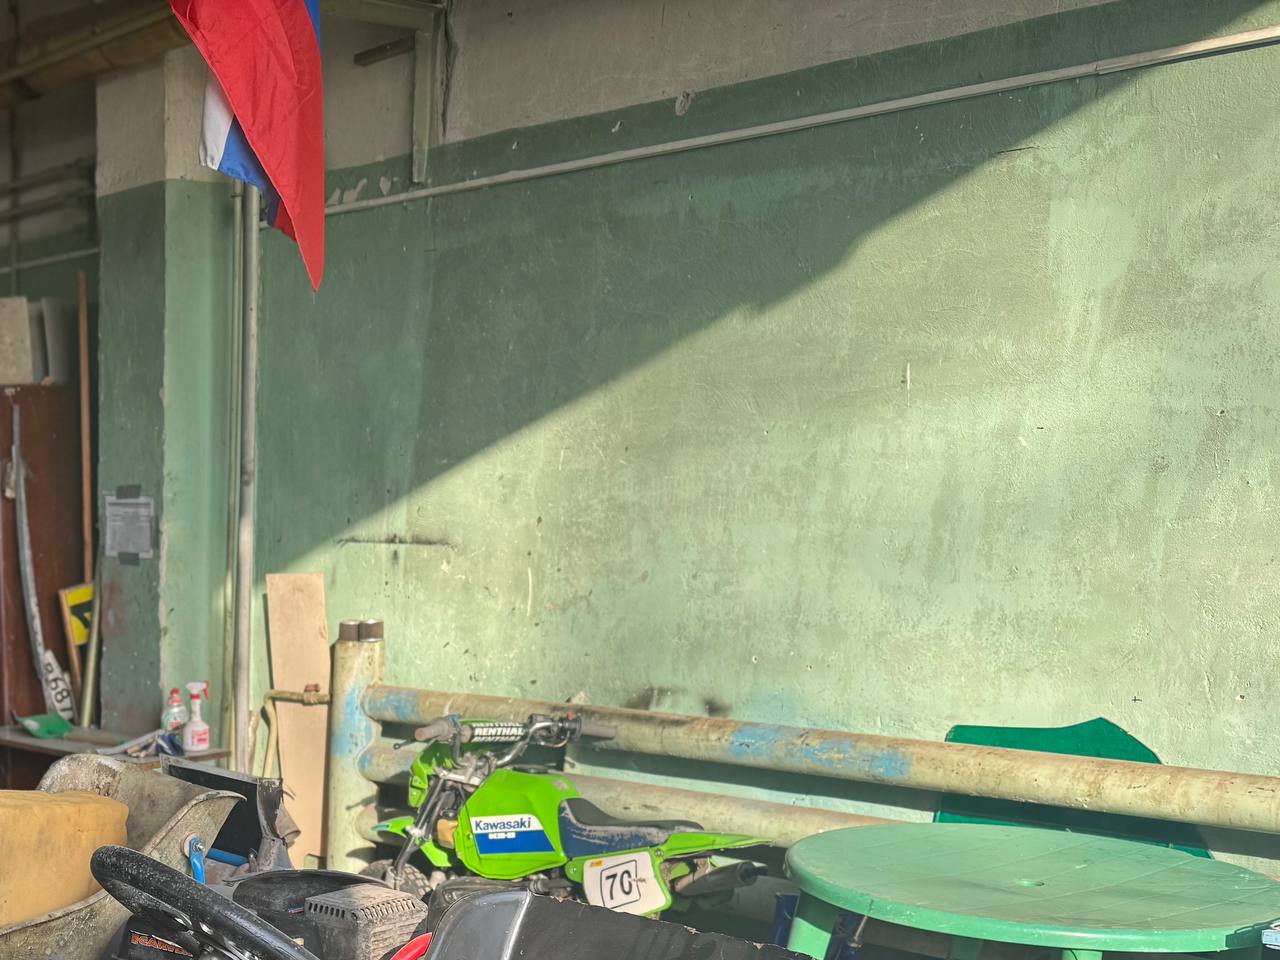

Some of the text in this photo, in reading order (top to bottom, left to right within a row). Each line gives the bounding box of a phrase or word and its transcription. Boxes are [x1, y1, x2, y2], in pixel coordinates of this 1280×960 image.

[474, 727, 524, 736] RENTHAL
[475, 817, 531, 831] Kawasaki
[605, 869, 633, 900] 70
